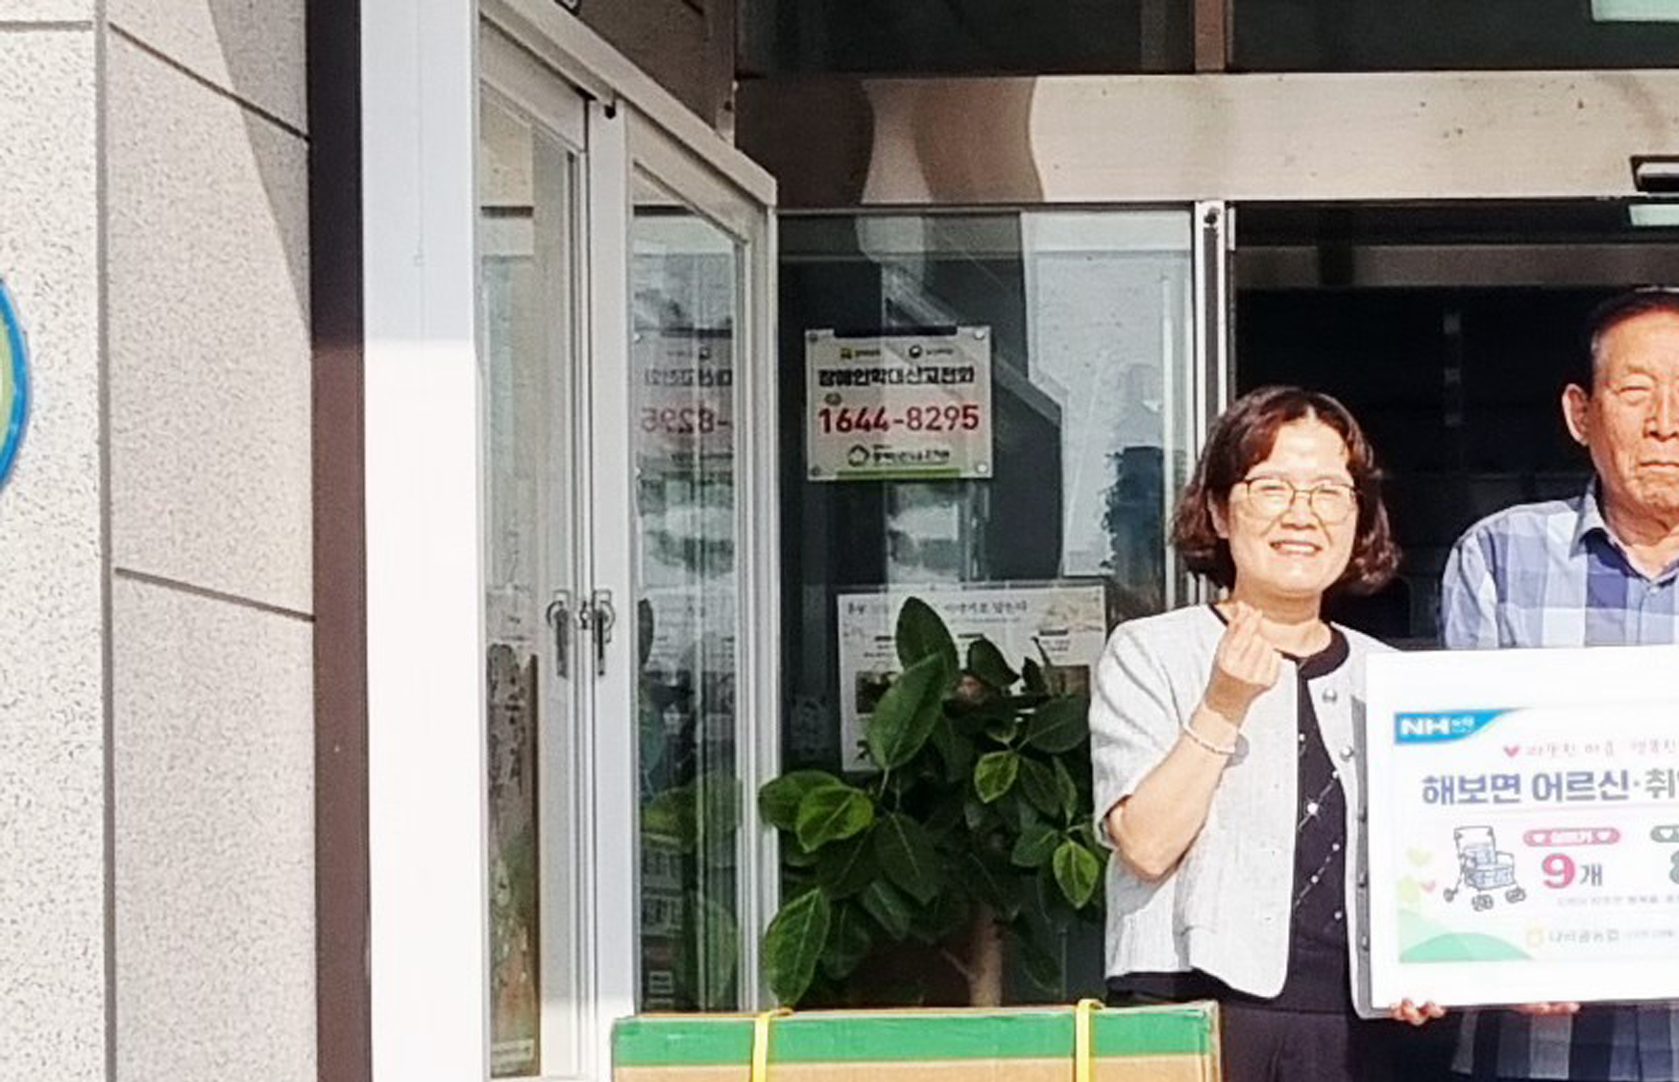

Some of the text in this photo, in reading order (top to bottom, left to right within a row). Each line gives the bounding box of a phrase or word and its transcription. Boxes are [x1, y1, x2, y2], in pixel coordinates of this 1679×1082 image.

[819, 404, 979, 434] 1644-8295
[1422, 774, 1521, 805] 해보면
[1541, 853, 1603, 889] 9개
